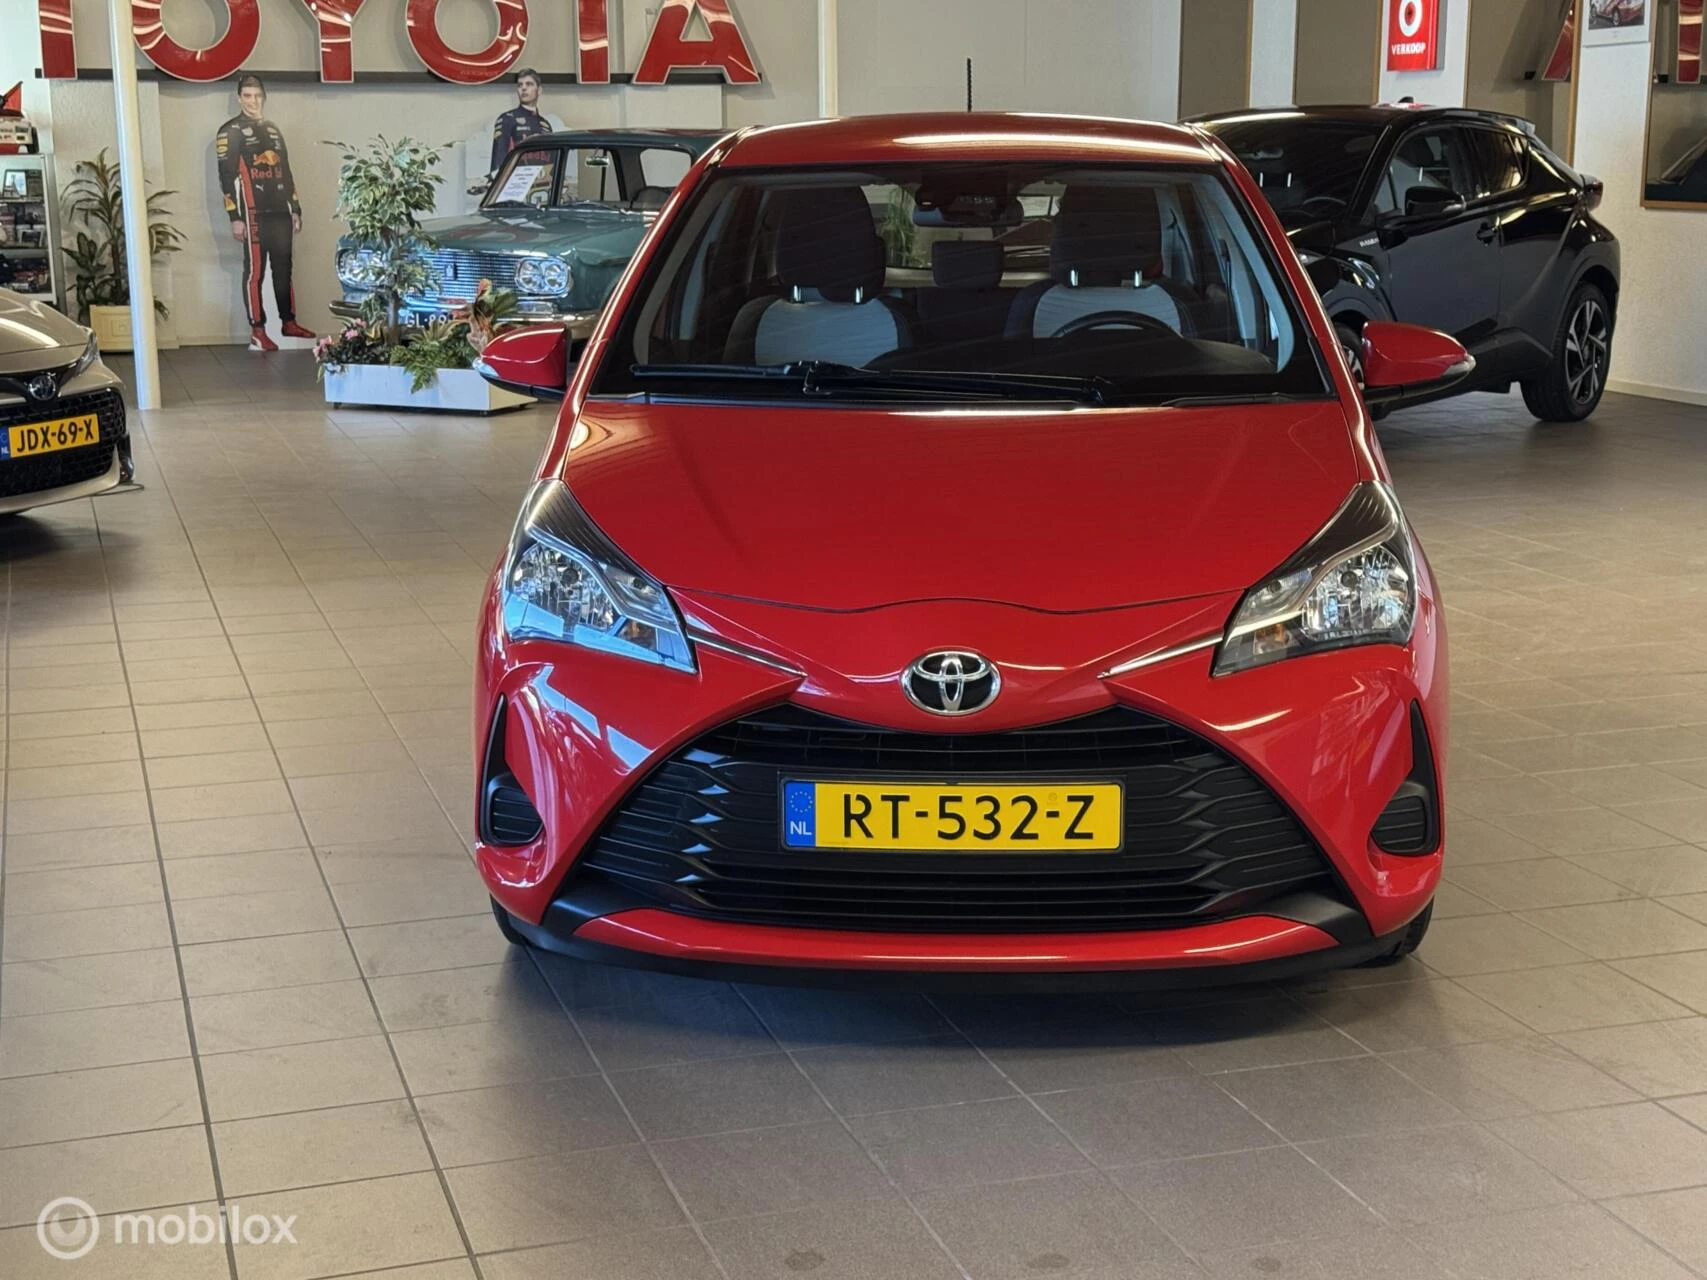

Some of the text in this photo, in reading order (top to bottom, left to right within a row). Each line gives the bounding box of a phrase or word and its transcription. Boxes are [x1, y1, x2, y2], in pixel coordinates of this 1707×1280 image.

[1391, 42, 1426, 56] VERKOOP
[17, 418, 94, 453] JDX-69-X
[790, 821, 812, 836] NL
[843, 793, 1094, 840] RT-532-Z
